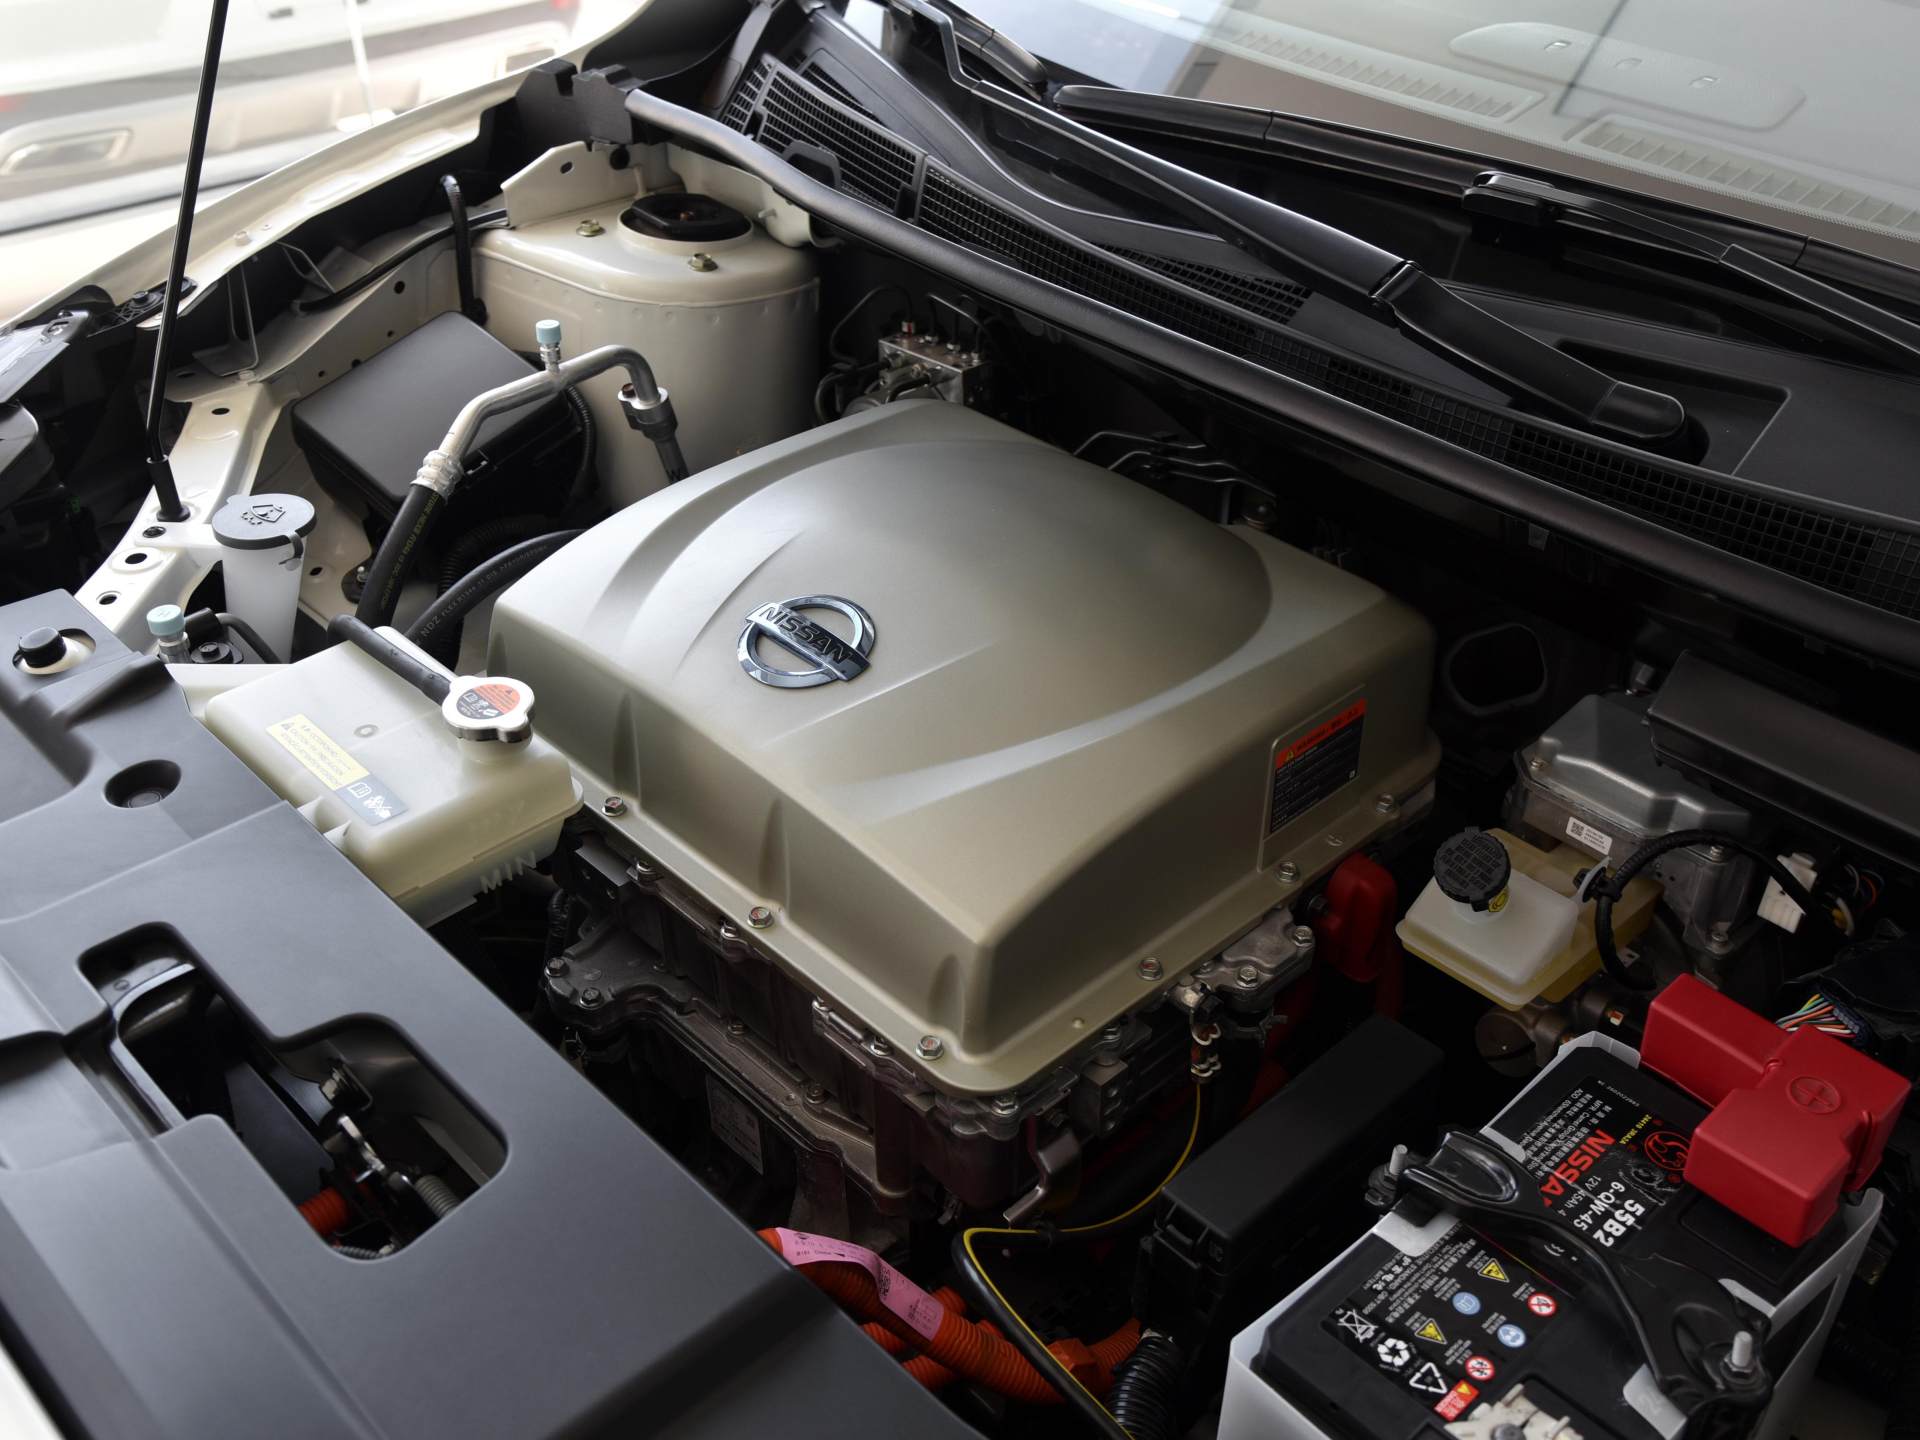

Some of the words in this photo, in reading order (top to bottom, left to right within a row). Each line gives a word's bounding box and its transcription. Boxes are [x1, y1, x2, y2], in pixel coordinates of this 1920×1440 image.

[758, 606, 854, 665] NISSAN
[480, 849, 537, 894] MIN
[1540, 1128, 1616, 1208] NISSA
[1584, 1175, 1602, 1191] 12V
[1573, 1181, 1625, 1231] 6-QW-45
